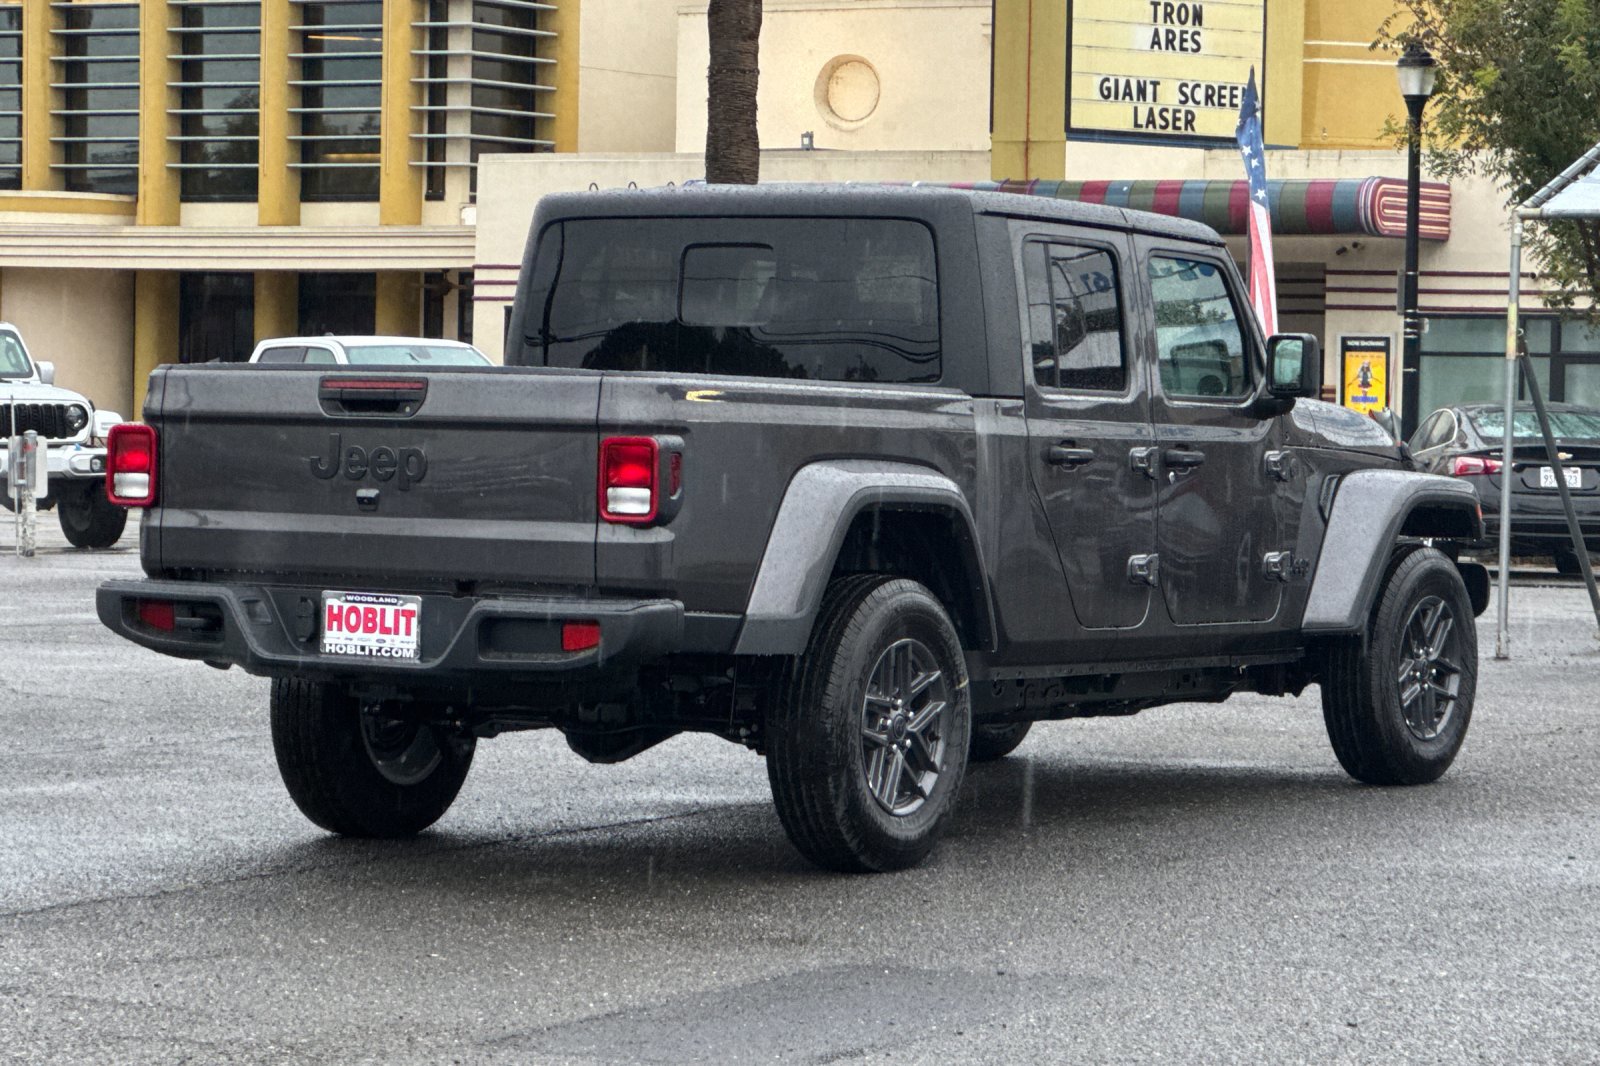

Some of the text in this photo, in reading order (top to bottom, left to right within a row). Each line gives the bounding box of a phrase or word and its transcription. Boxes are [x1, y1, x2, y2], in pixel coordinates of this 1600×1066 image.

[1150, 1, 1203, 27] TRON
[1150, 28, 1201, 53] ARES
[1099, 77, 1160, 103] GIANT
[1133, 106, 1196, 132] LASER
[310, 432, 428, 491] Jeep
[346, 595, 397, 604] WOODLAND
[327, 604, 416, 636] HOBLIT
[325, 643, 414, 658] HOBLIT.COM
